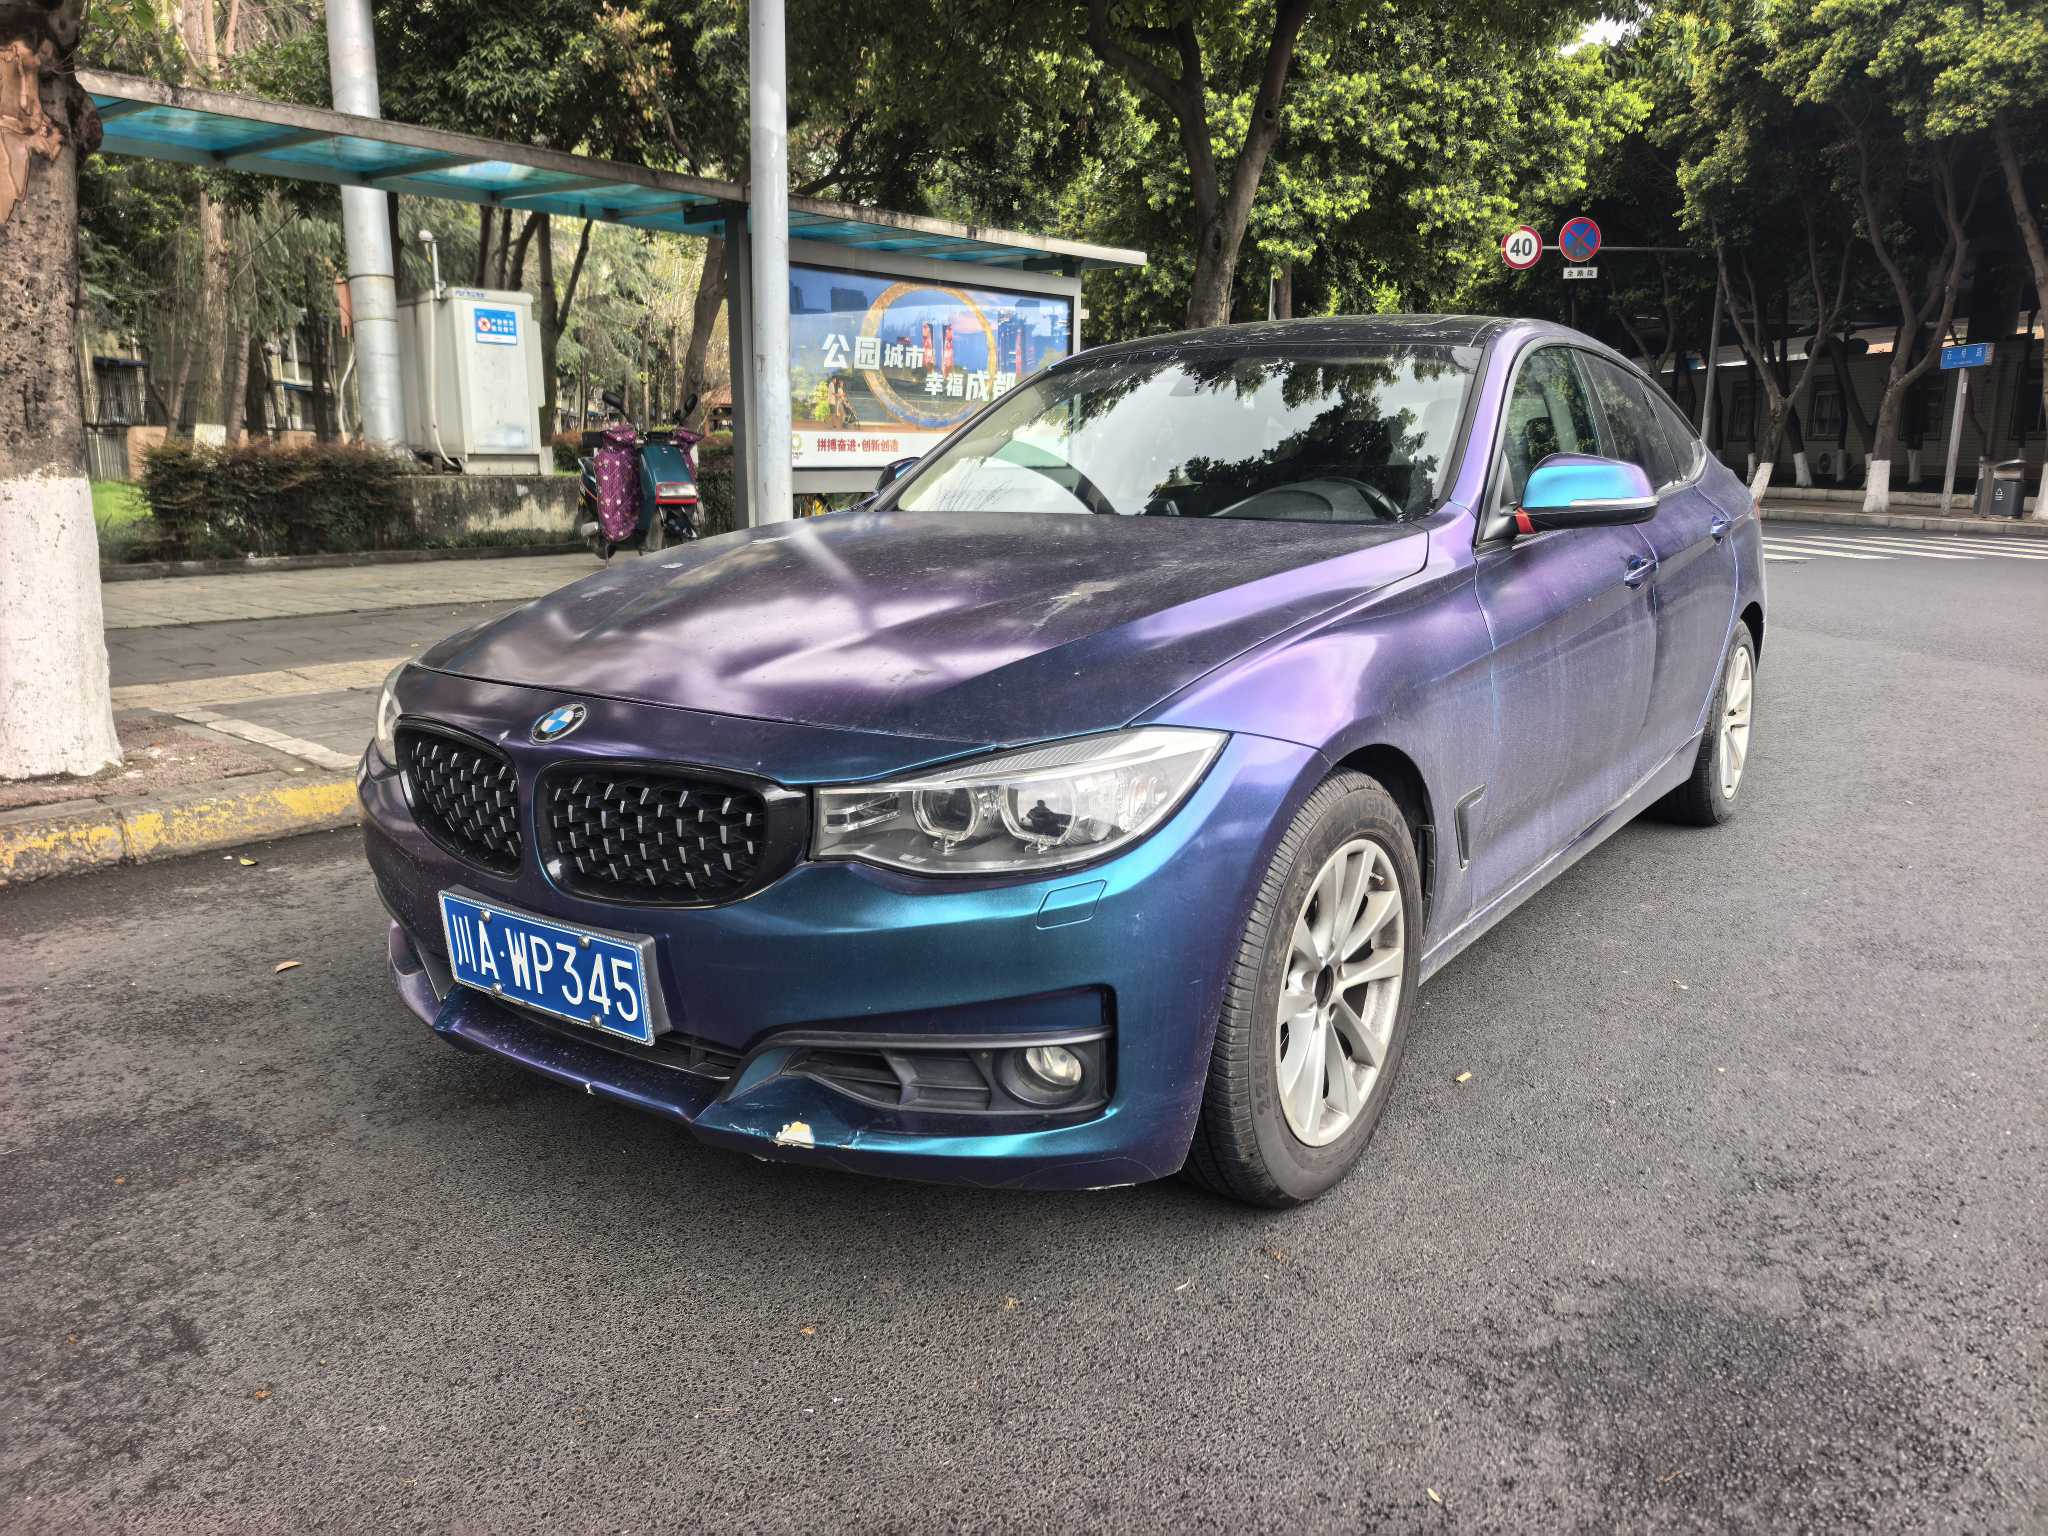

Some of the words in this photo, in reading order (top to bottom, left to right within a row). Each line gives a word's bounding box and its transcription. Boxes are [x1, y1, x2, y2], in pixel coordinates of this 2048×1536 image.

[1510, 238, 1532, 257] 40
[822, 333, 924, 370] 公园城市
[925, 367, 1017, 402] 幸福成都
[452, 914, 639, 1022] 川A·WP345
